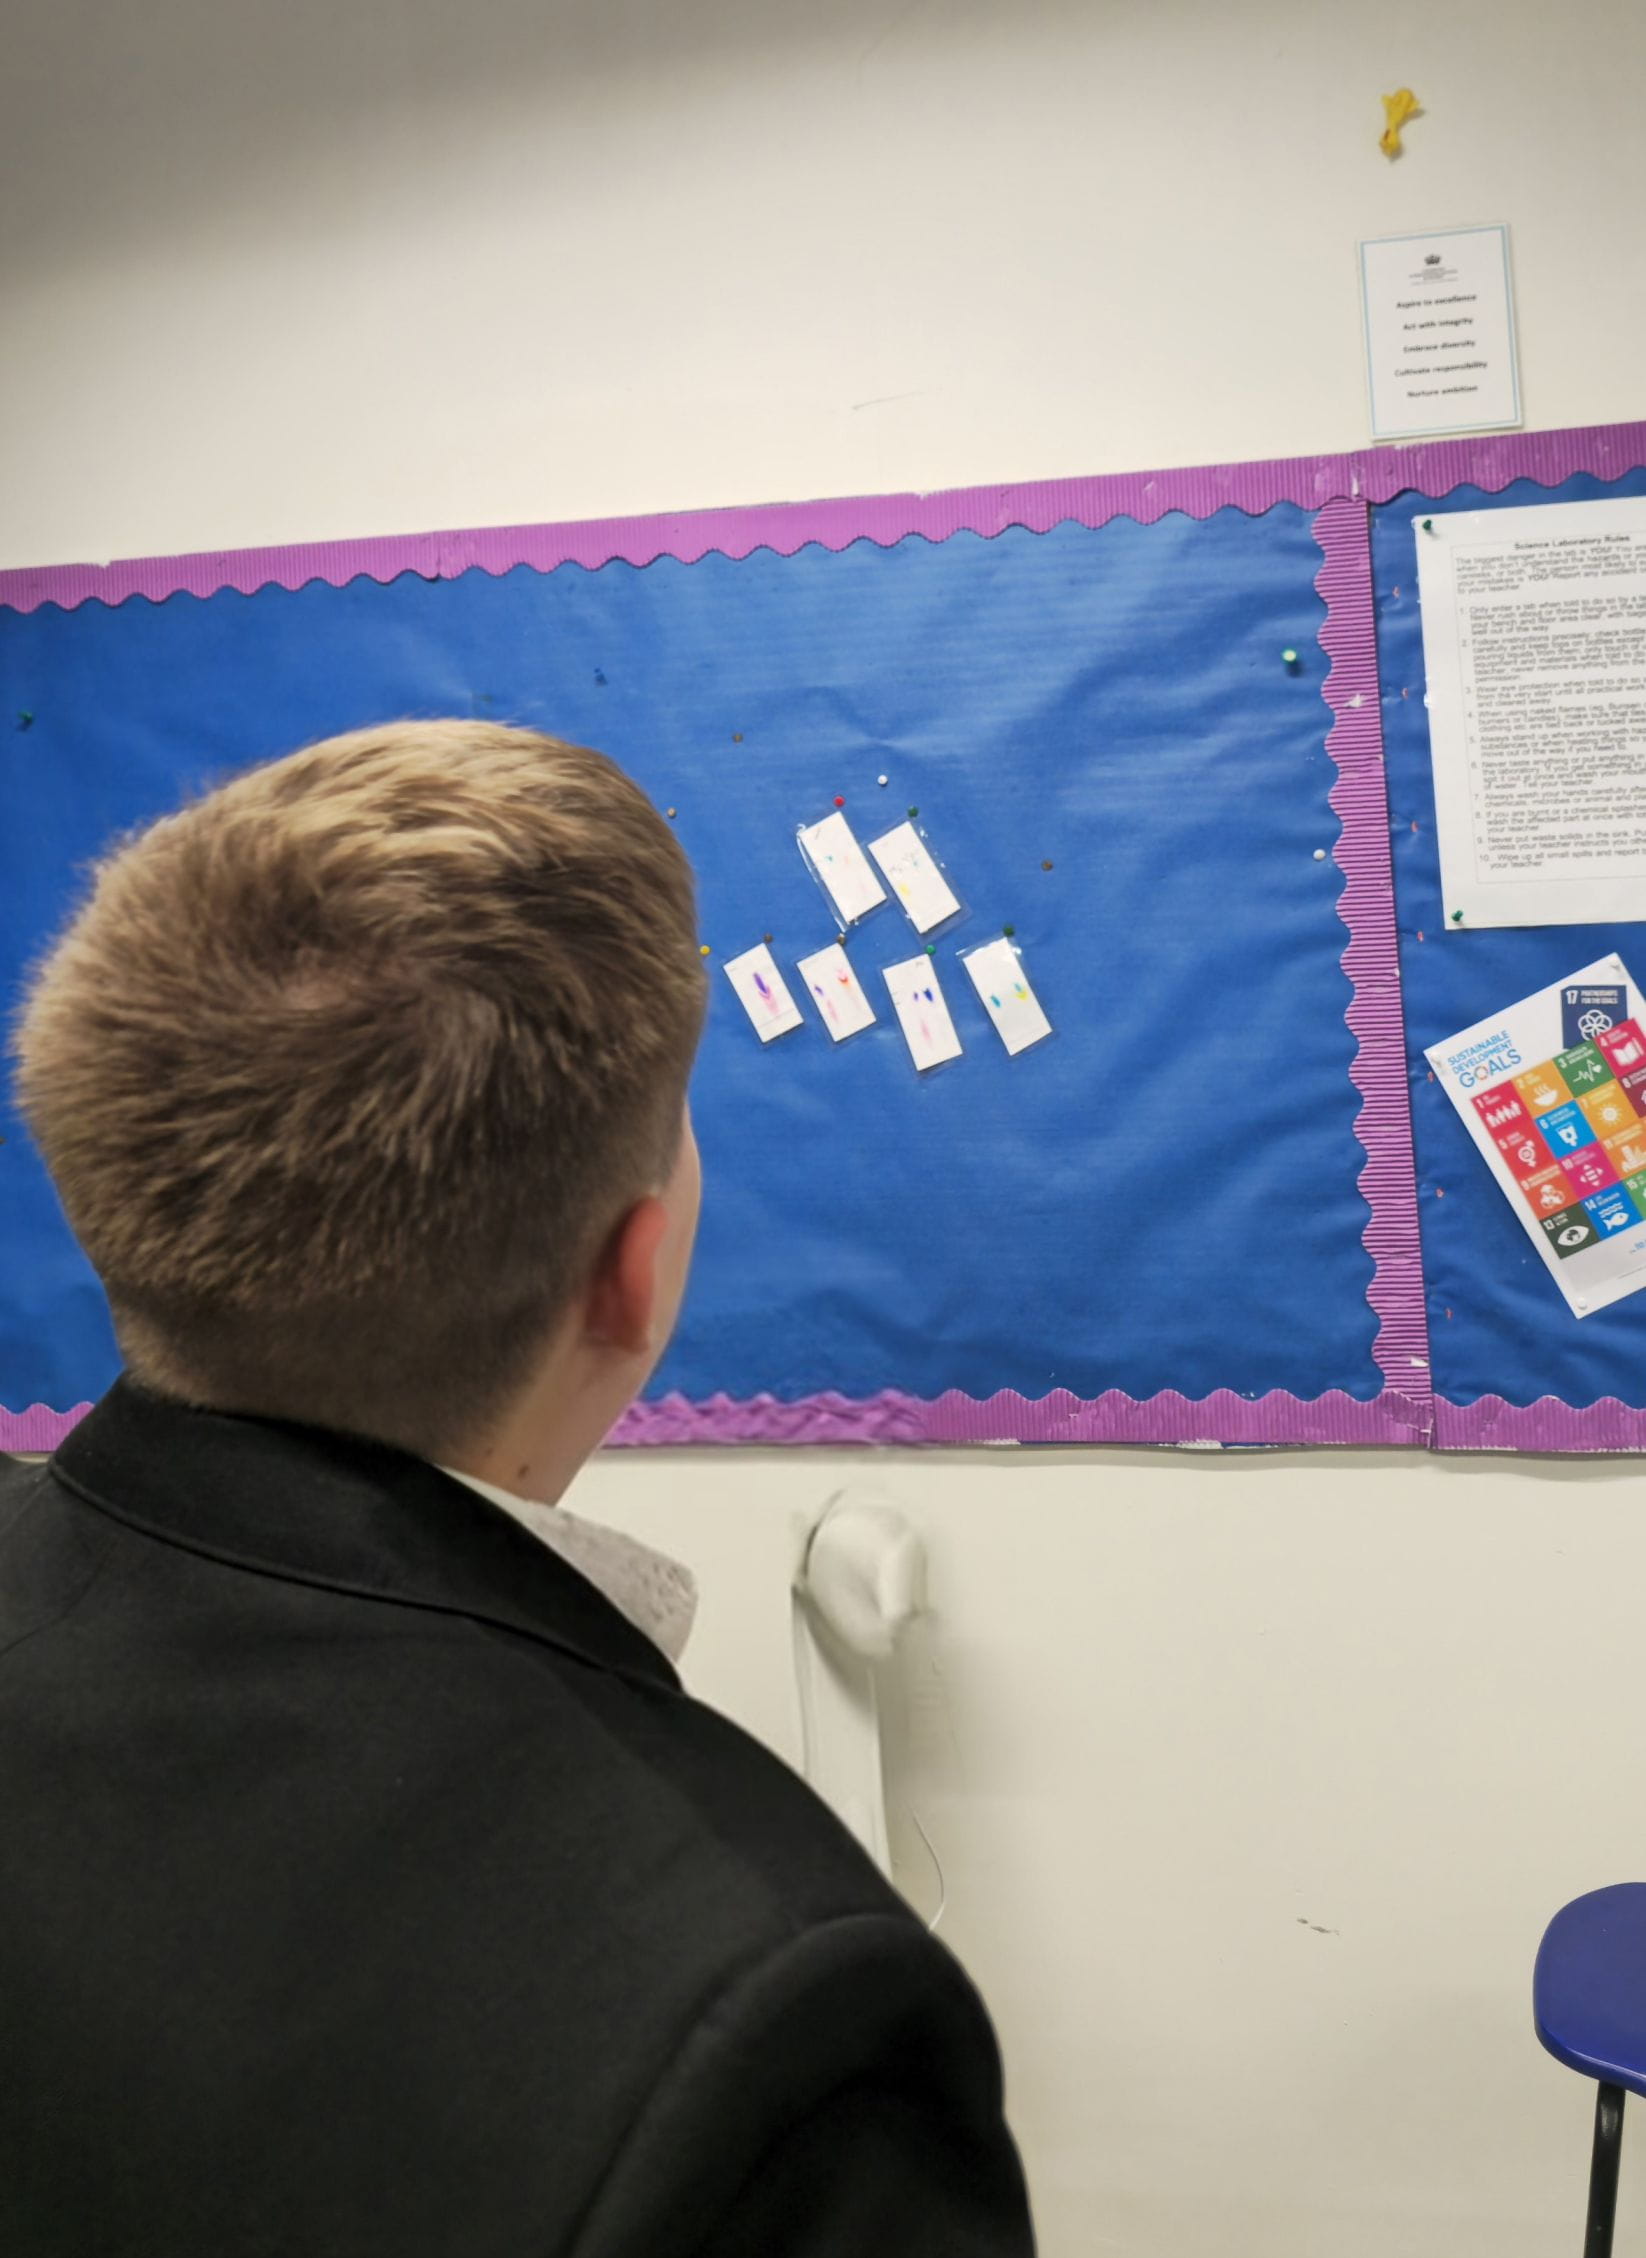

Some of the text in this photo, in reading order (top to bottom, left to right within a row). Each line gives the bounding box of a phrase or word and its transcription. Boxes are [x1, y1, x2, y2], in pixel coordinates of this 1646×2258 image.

[1396, 301, 1421, 310] Aspire
[1434, 294, 1476, 304] excellence
[1419, 320, 1436, 329] with
[1438, 318, 1473, 328] integrity
[1403, 340, 1475, 353] Embrace diversity
[1394, 361, 1488, 377] Cultivate responsibility
[1407, 385, 1478, 398] Nurture ambition
[1514, 534, 1630, 551] Science Laboratory Rules
[1566, 990, 1578, 1004] 17
[1448, 1030, 1510, 1065] SUSTAINABLE
[1600, 1036, 1609, 1047] 4
[1452, 1040, 1512, 1074] DEVELOPMENT
[1558, 1058, 1568, 1068] 3
[1459, 1048, 1522, 1088] GOALS
